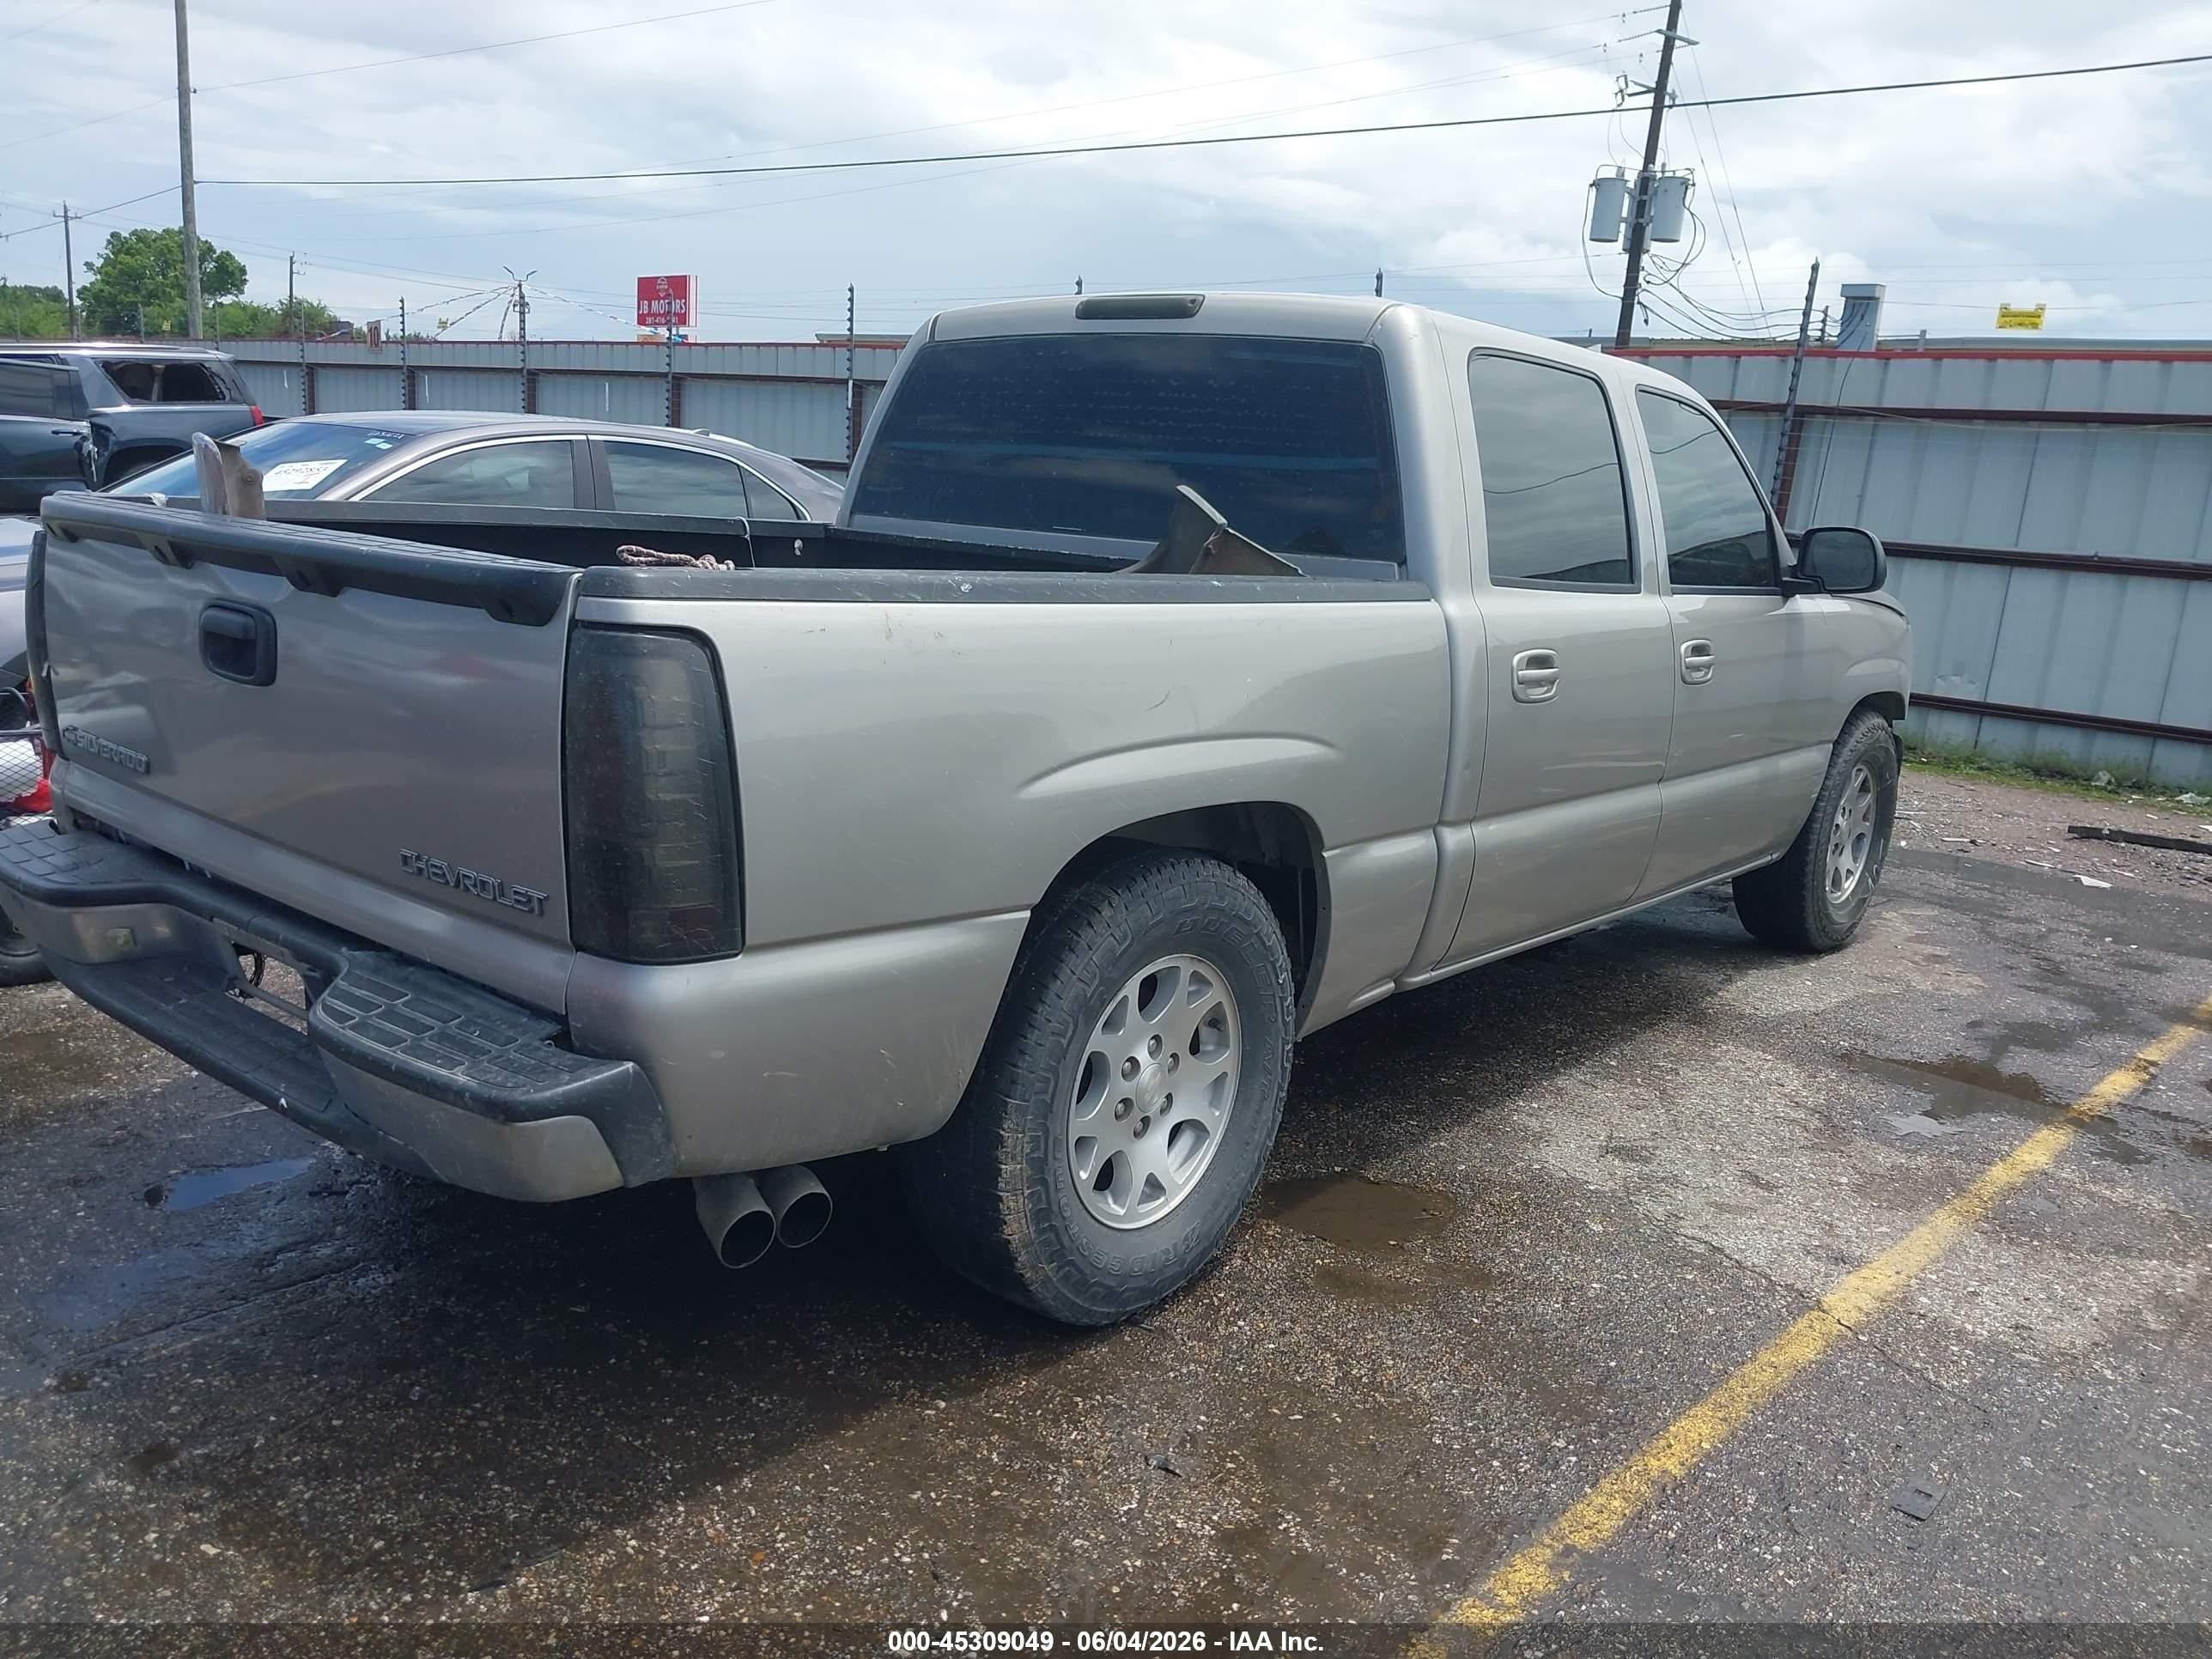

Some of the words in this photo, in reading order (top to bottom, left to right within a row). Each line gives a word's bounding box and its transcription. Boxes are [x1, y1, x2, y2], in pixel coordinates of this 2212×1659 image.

[639, 300, 648, 314] JB
[70, 728, 149, 775] SILVERADO
[398, 848, 550, 916] CHEVROLET
[1172, 915, 1278, 1024] DUELER
[1053, 1134, 1201, 1277] BRIDGESTONE
